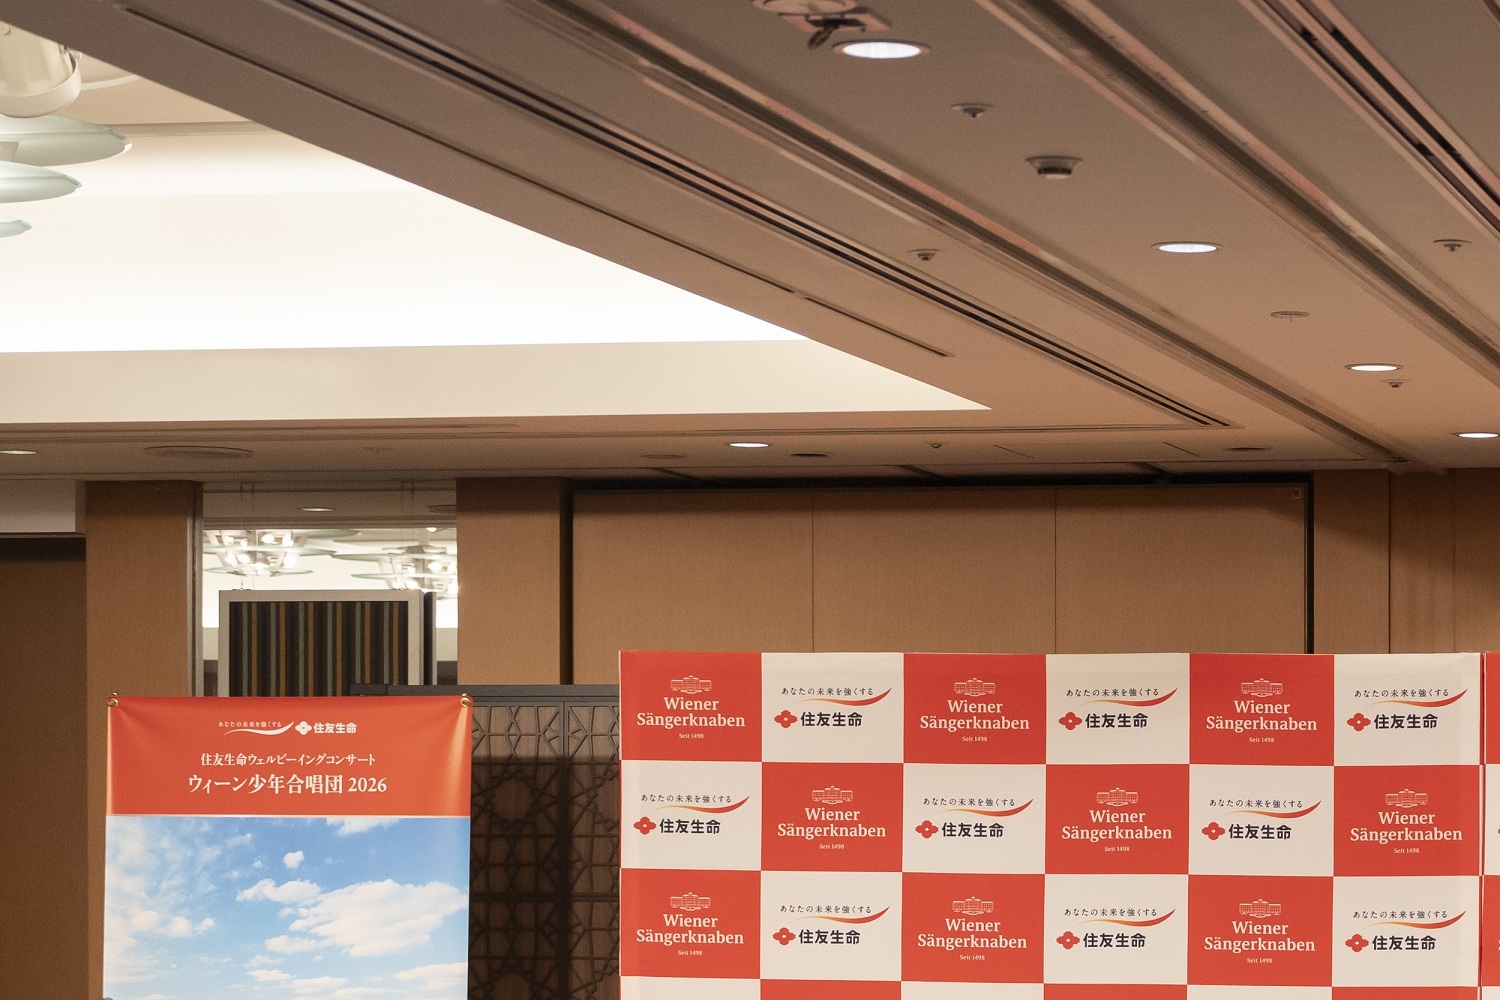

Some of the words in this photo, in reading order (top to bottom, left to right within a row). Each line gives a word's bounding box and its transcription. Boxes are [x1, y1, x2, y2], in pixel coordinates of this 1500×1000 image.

[781, 687, 873, 696] あなたの未来を強くする
[1354, 688, 1449, 698] あなたの未来を強くする
[663, 696, 720, 711] Wiener
[947, 699, 1004, 714] Wiener
[1233, 699, 1291, 714] Wiener
[218, 720, 282, 728] あなたの未来を強くする
[636, 712, 746, 730] Sängerknaben
[800, 711, 863, 727] 住友生命
[920, 715, 1030, 733] Sängerknaben
[1084, 712, 1149, 729] 住友生命
[1206, 715, 1318, 733] Sängerknaben
[1373, 713, 1439, 730] 住友生命
[313, 722, 357, 734] 住友生命
[200, 752, 376, 768] 住友生命ウェルビーイングコンサート
[187, 774, 344, 795] ウィーン少年合唱団
[347, 776, 388, 793] 2026
[923, 797, 1015, 807] あなたの未来を強くする
[804, 807, 861, 821] Wiener
[1089, 809, 1146, 823] Wiener
[1377, 810, 1436, 825] Wiener
[659, 818, 721, 835] 住友生命
[777, 823, 886, 841] Sängerknaben
[941, 821, 1005, 838] 住友生命
[1061, 825, 1173, 843] Sängerknaben
[1228, 823, 1292, 840] 住友生命
[1350, 826, 1463, 845] Sängerknaben
[662, 913, 719, 928] Wiener
[1065, 908, 1157, 917] あなたの未来を強くする
[944, 917, 1002, 932] Wiener
[1231, 920, 1289, 935] Wiener
[636, 928, 744, 947] Sängerknaben
[798, 928, 861, 945] 住友生命
[917, 933, 1027, 951] Sängerknaben
[1082, 932, 1147, 948] 住友生命
[1371, 935, 1437, 951] 住友生命
[1204, 936, 1316, 954] Sängerknaben
